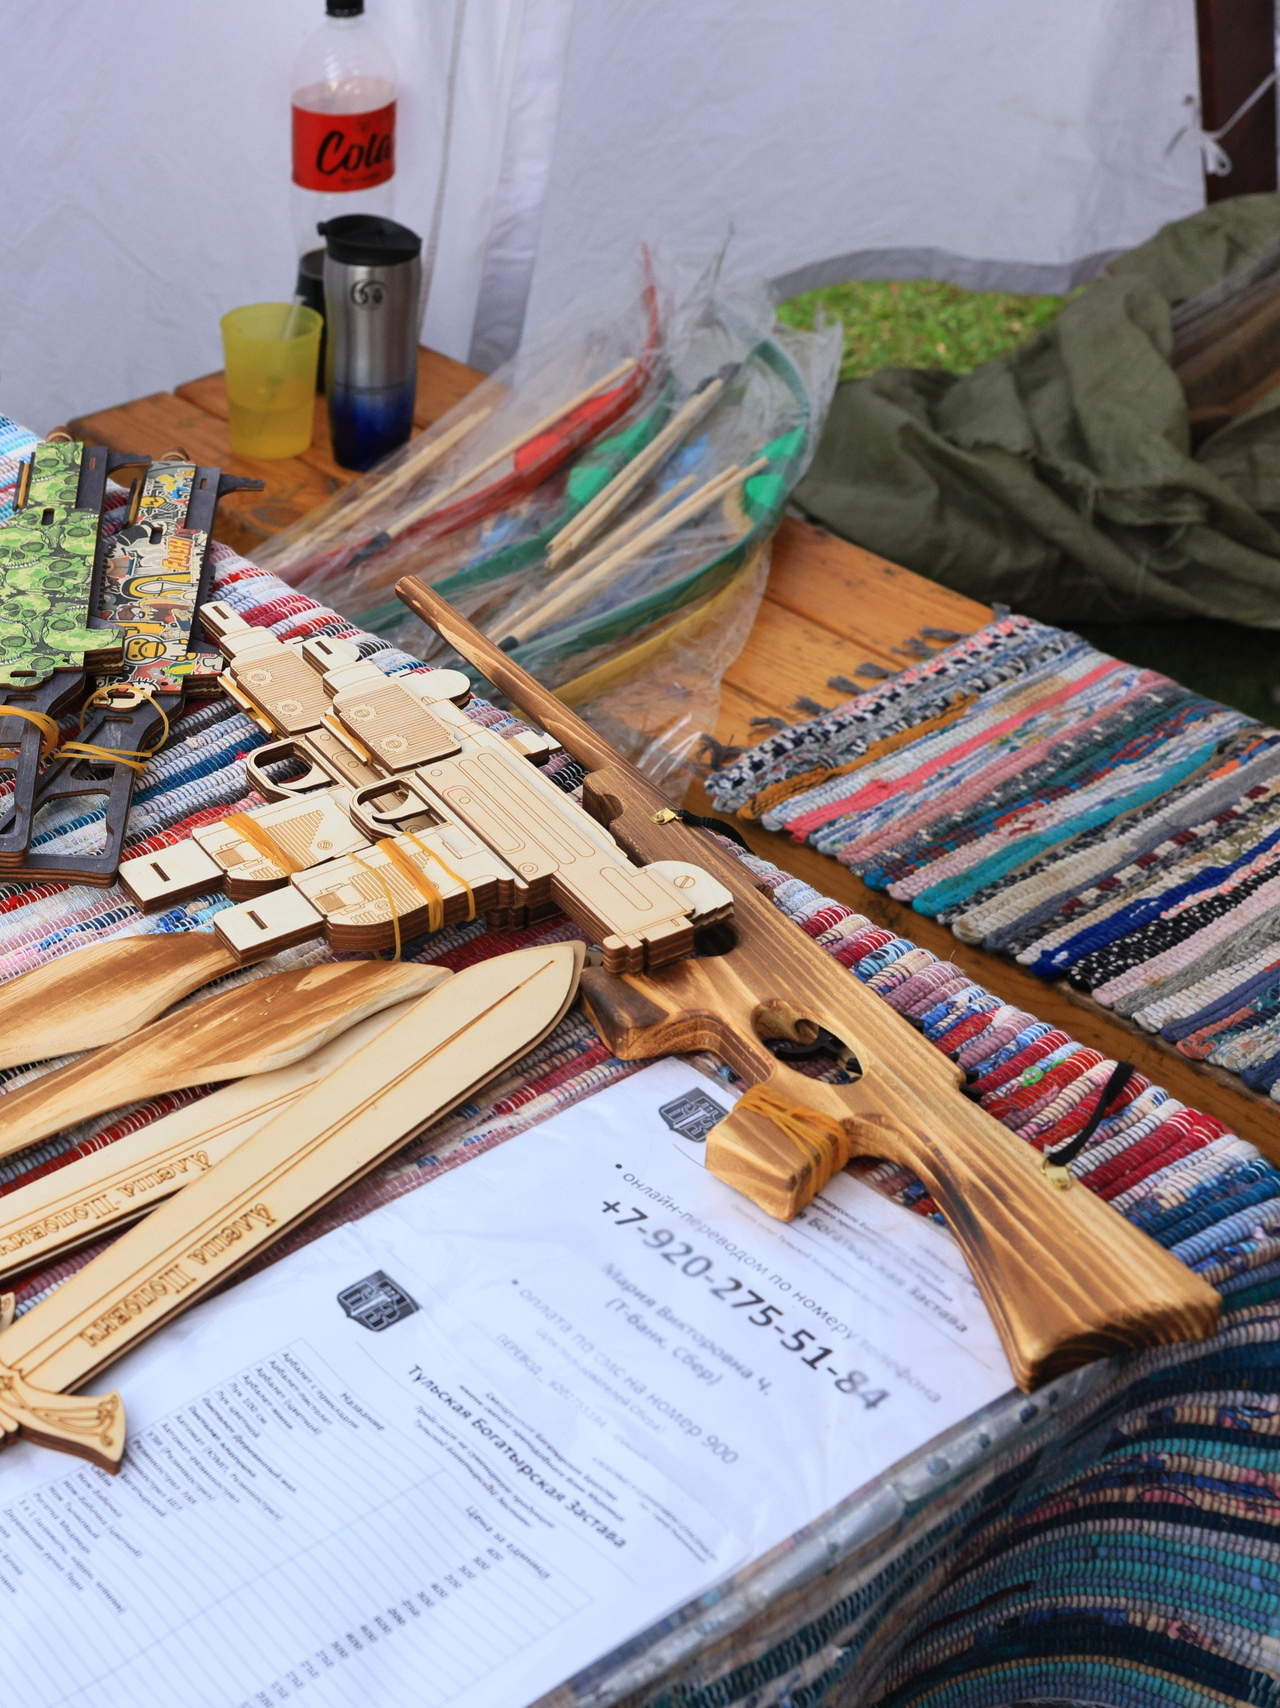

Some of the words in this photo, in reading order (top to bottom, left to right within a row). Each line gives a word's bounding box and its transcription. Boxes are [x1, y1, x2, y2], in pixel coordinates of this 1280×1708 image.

[315, 130, 391, 176] Cola
[163, 536, 193, 572] FLASH
[623, 1173, 767, 1279] онлайн-переводом
[768, 1274, 792, 1291] по
[792, 1292, 855, 1339] номеру
[79, 1265, 195, 1346] Попович
[600, 1197, 893, 1413] +7-920-275-51-84
[602, 1263, 656, 1307] Мария
[656, 1306, 753, 1379] Викторовна
[605, 1298, 665, 1349] (Т-банк,
[672, 1347, 722, 1386] Сбер)
[409, 1365, 472, 1418] Тульская
[472, 1419, 564, 1501] Богатырская
[565, 1500, 626, 1548] Застава
[624, 1376, 647, 1395] на
[647, 1394, 702, 1437] номер
[702, 1435, 739, 1464] 900
